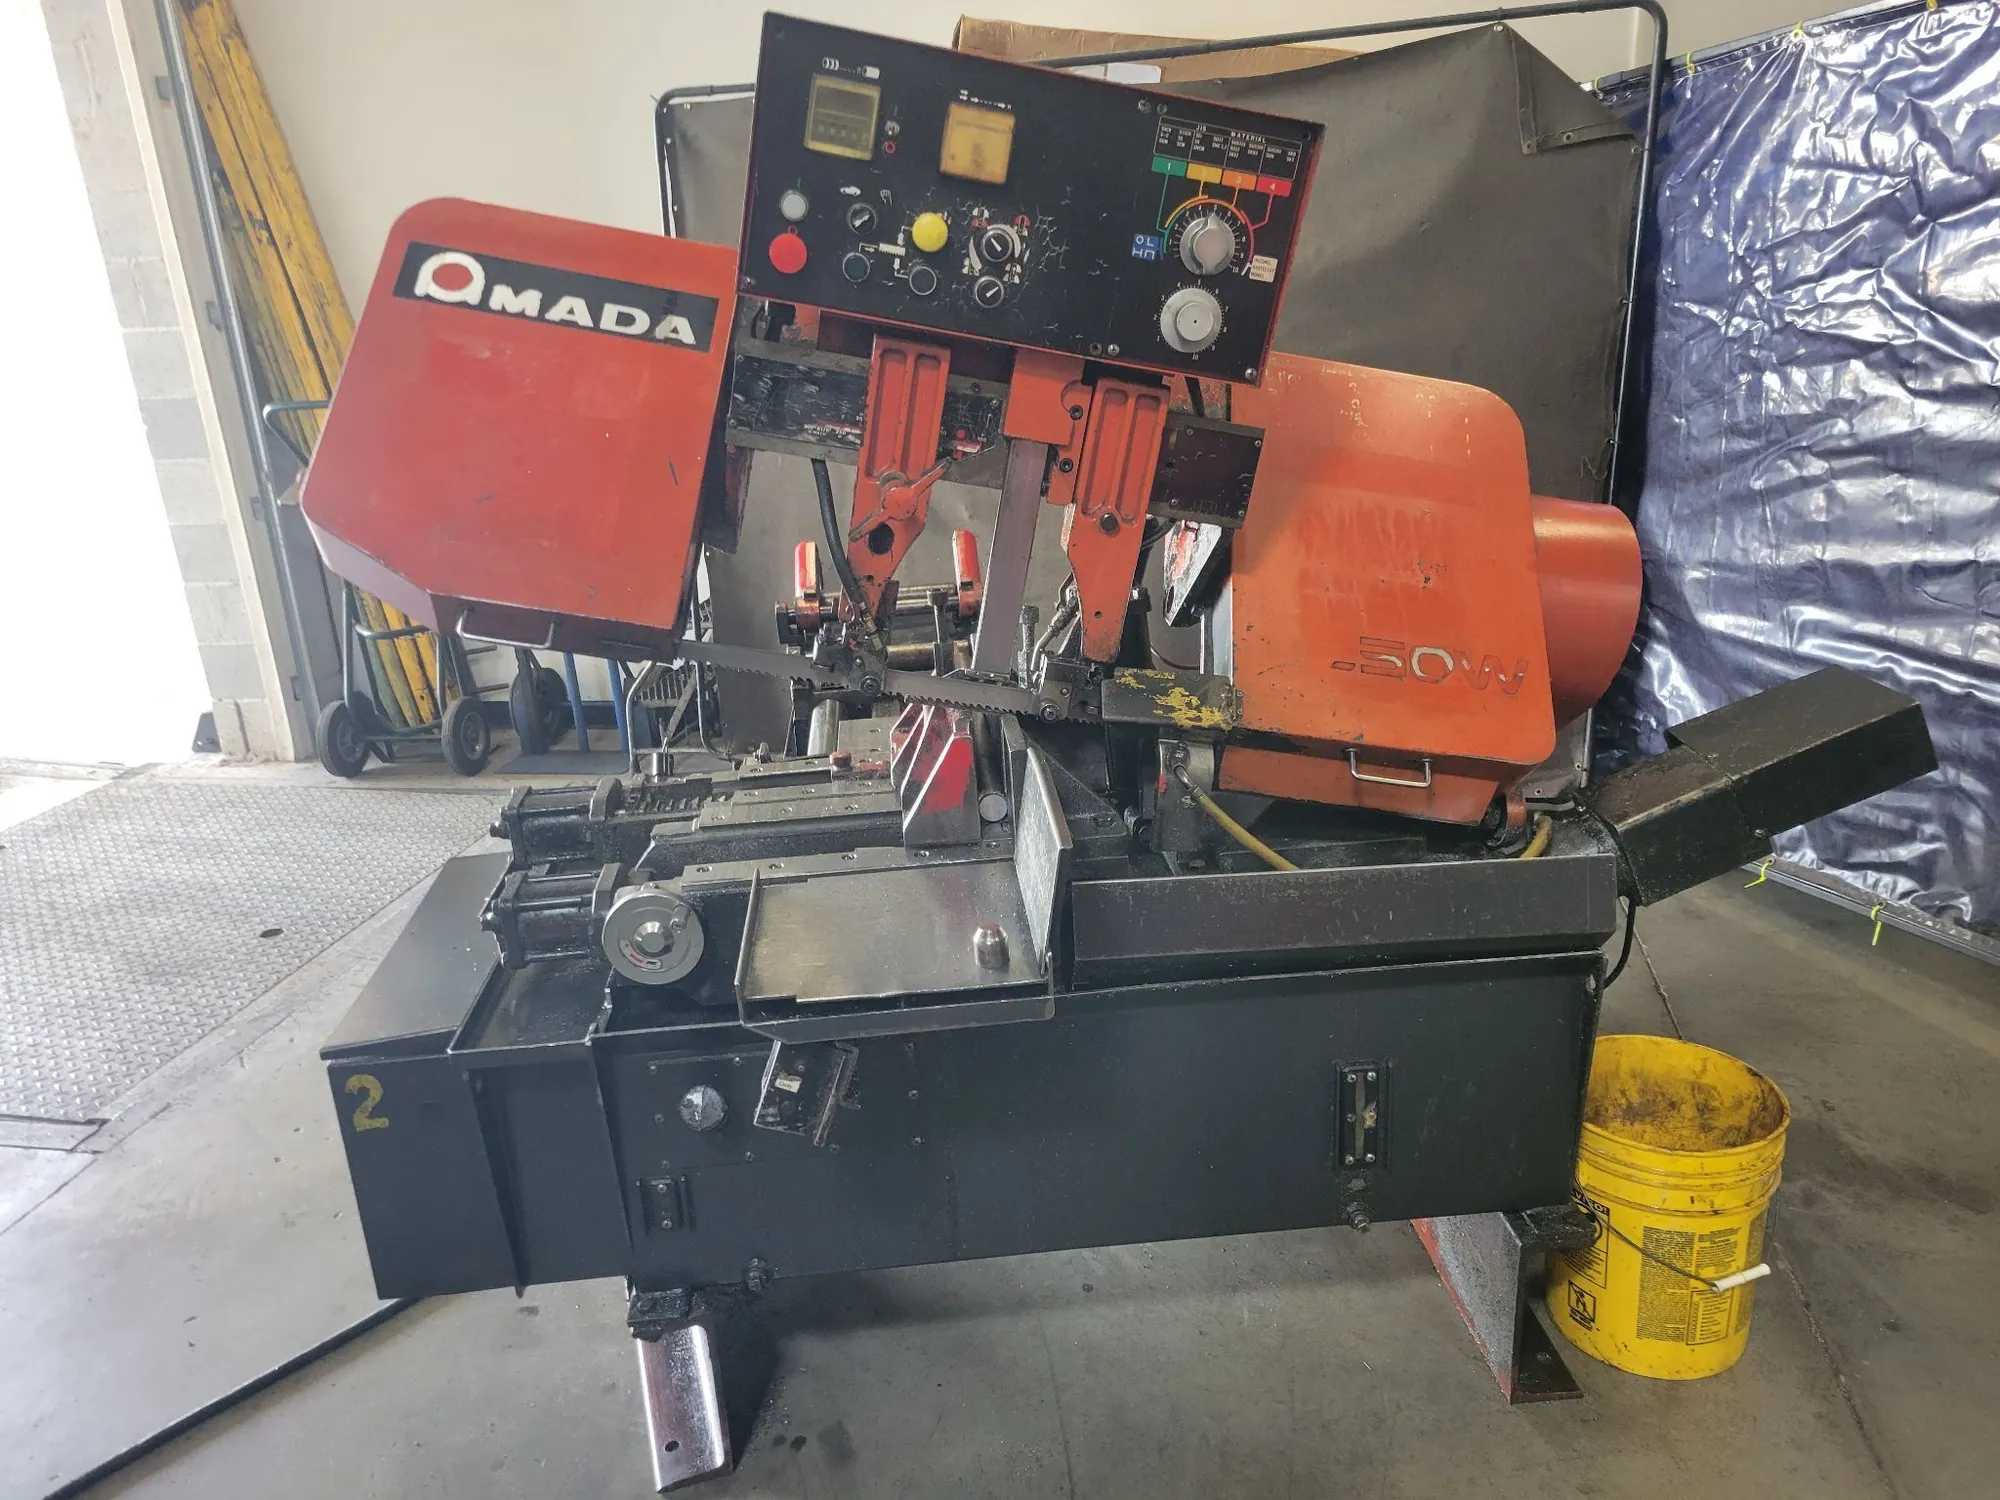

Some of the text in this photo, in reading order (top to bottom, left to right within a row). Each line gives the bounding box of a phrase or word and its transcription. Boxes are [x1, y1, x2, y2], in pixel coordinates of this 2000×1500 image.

[1231, 131, 1266, 143] MATERIAL
[1269, 183, 1276, 191] 4
[414, 251, 696, 345] AMADA
[345, 1074, 389, 1131] 2
